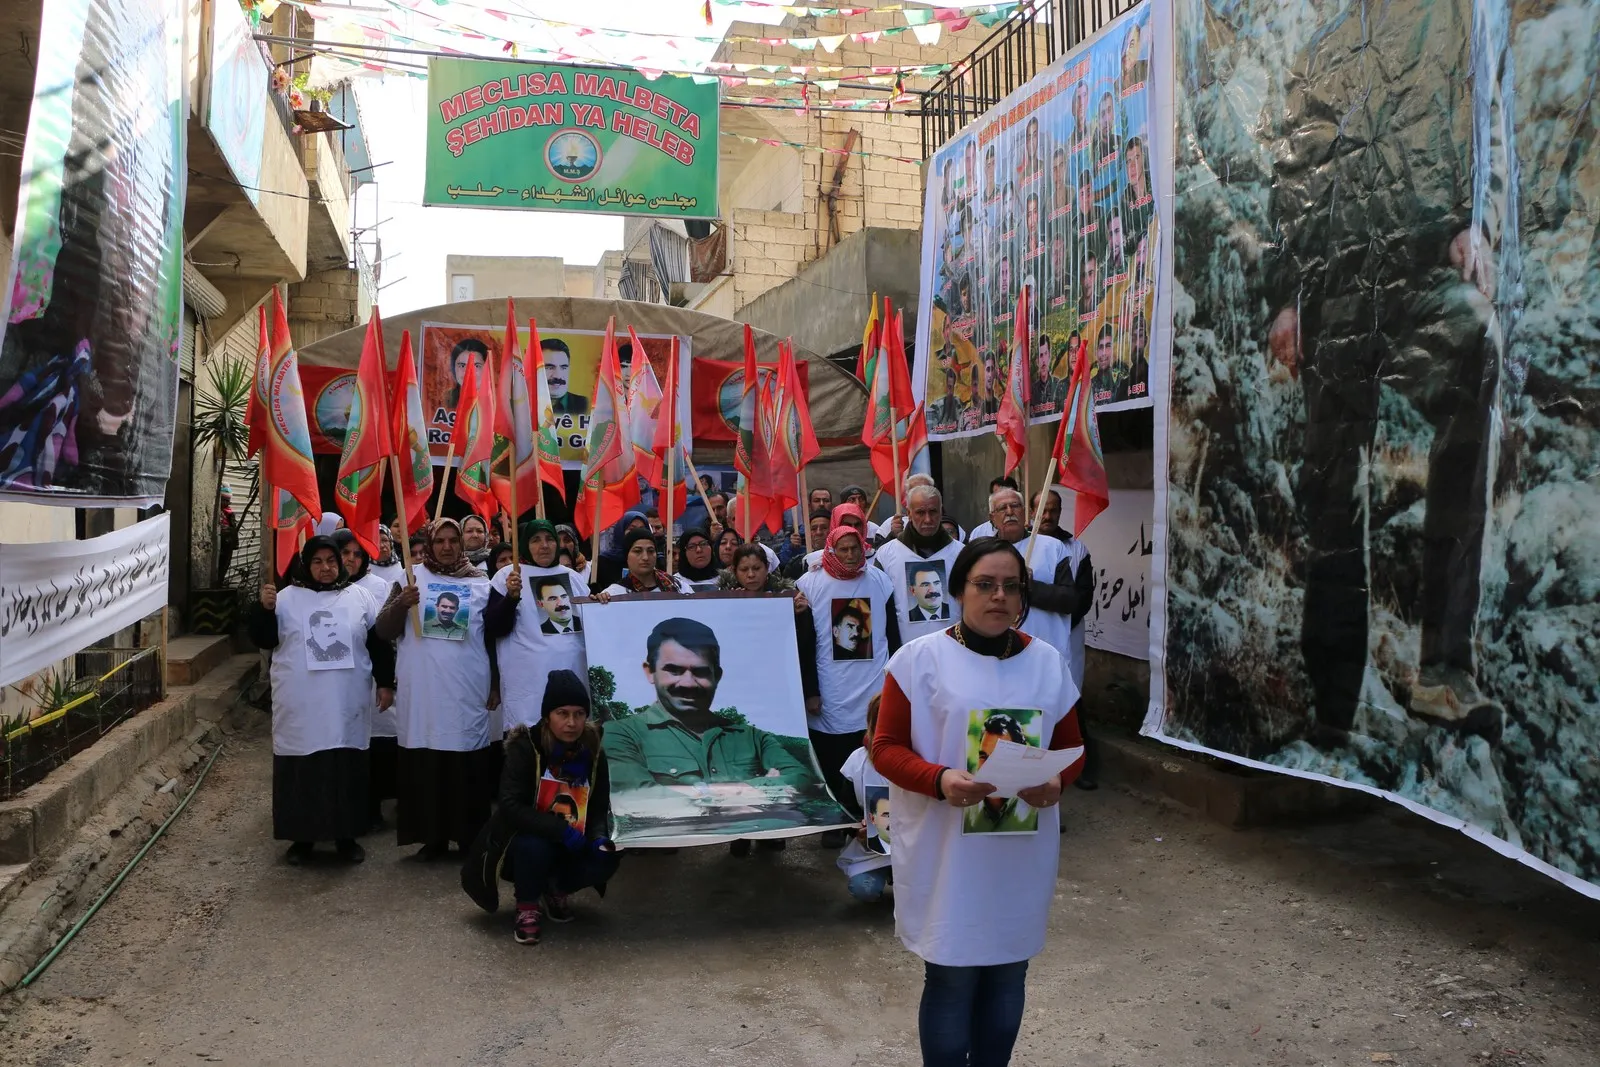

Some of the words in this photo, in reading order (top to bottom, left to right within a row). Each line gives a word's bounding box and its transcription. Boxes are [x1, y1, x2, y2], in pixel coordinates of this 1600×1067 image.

[439, 72, 567, 124] MECLISA
[575, 73, 700, 139] MALBETA
[445, 103, 563, 157] ŞEHÎDAN
[570, 104, 605, 129] YA
[612, 111, 694, 166] HELEB
[522, 185, 595, 203] الشهداء
[598, 190, 646, 207] عوائل
[649, 194, 697, 210] مجلس
